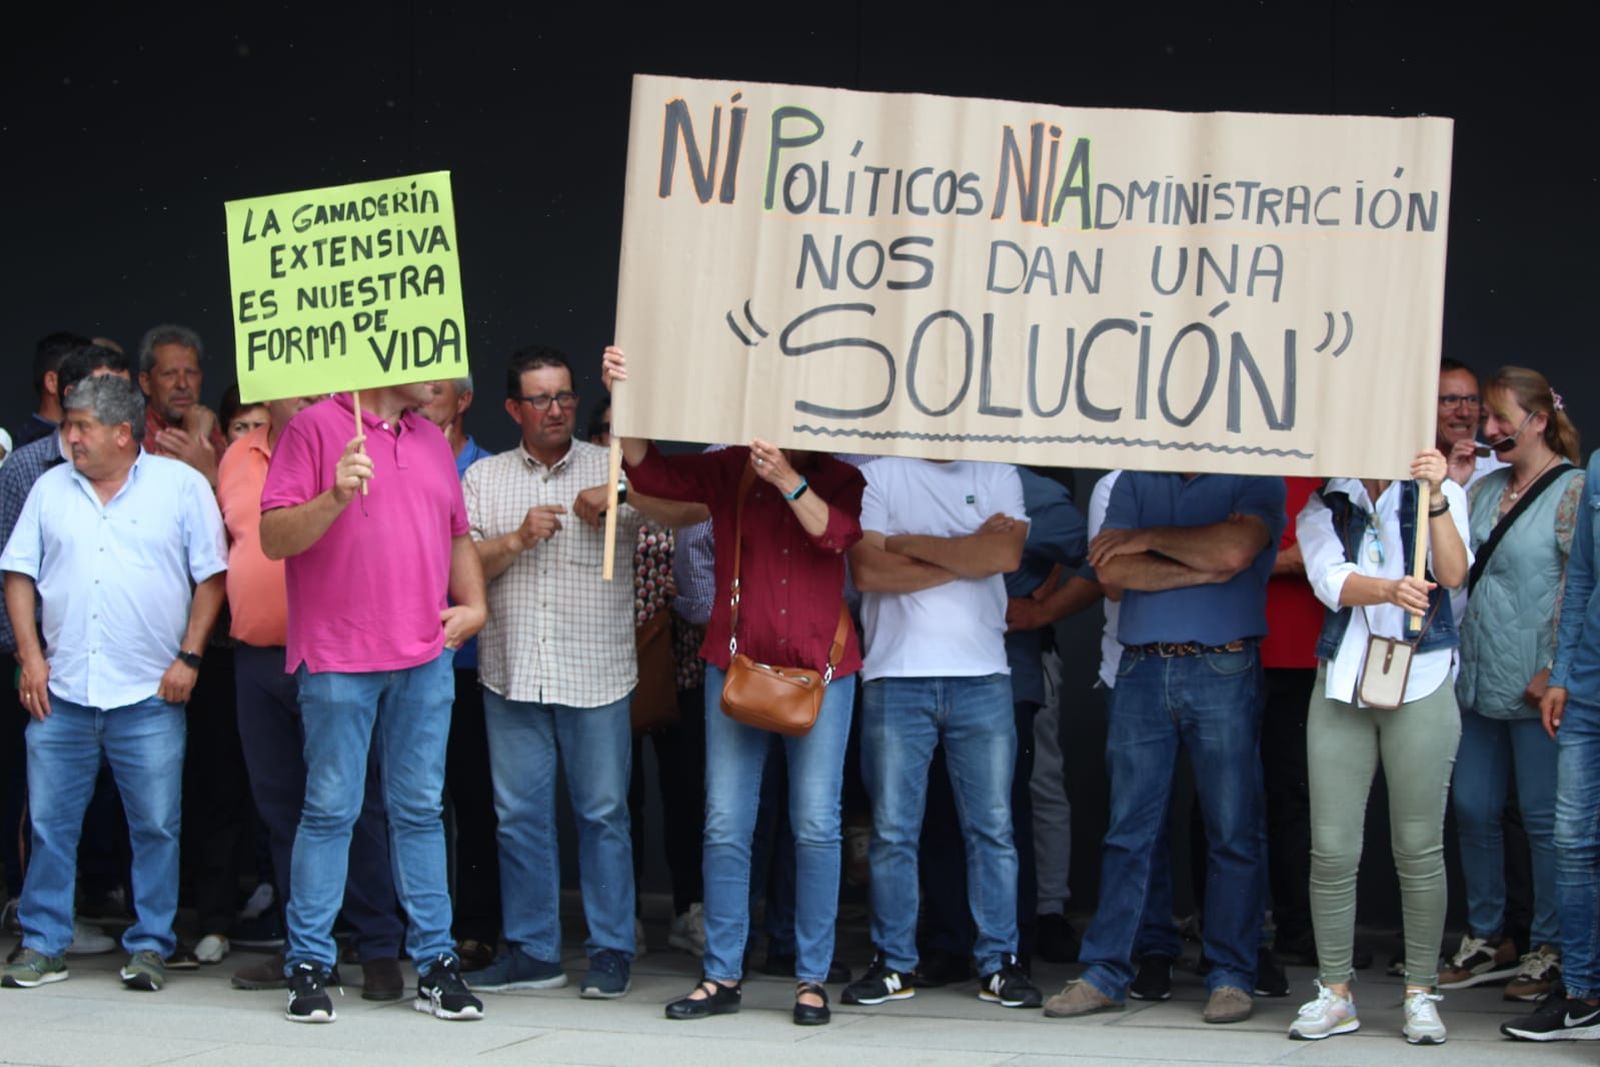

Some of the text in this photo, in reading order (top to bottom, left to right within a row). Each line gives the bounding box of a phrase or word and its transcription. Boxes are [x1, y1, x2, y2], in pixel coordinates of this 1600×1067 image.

[242, 208, 281, 244] LA
[270, 225, 450, 279] EXTENSIVA
[239, 264, 444, 323] ES NUESTRA
[796, 234, 1284, 303] NOS DAN UNA
[248, 309, 461, 373] FORMA DE VIDA
